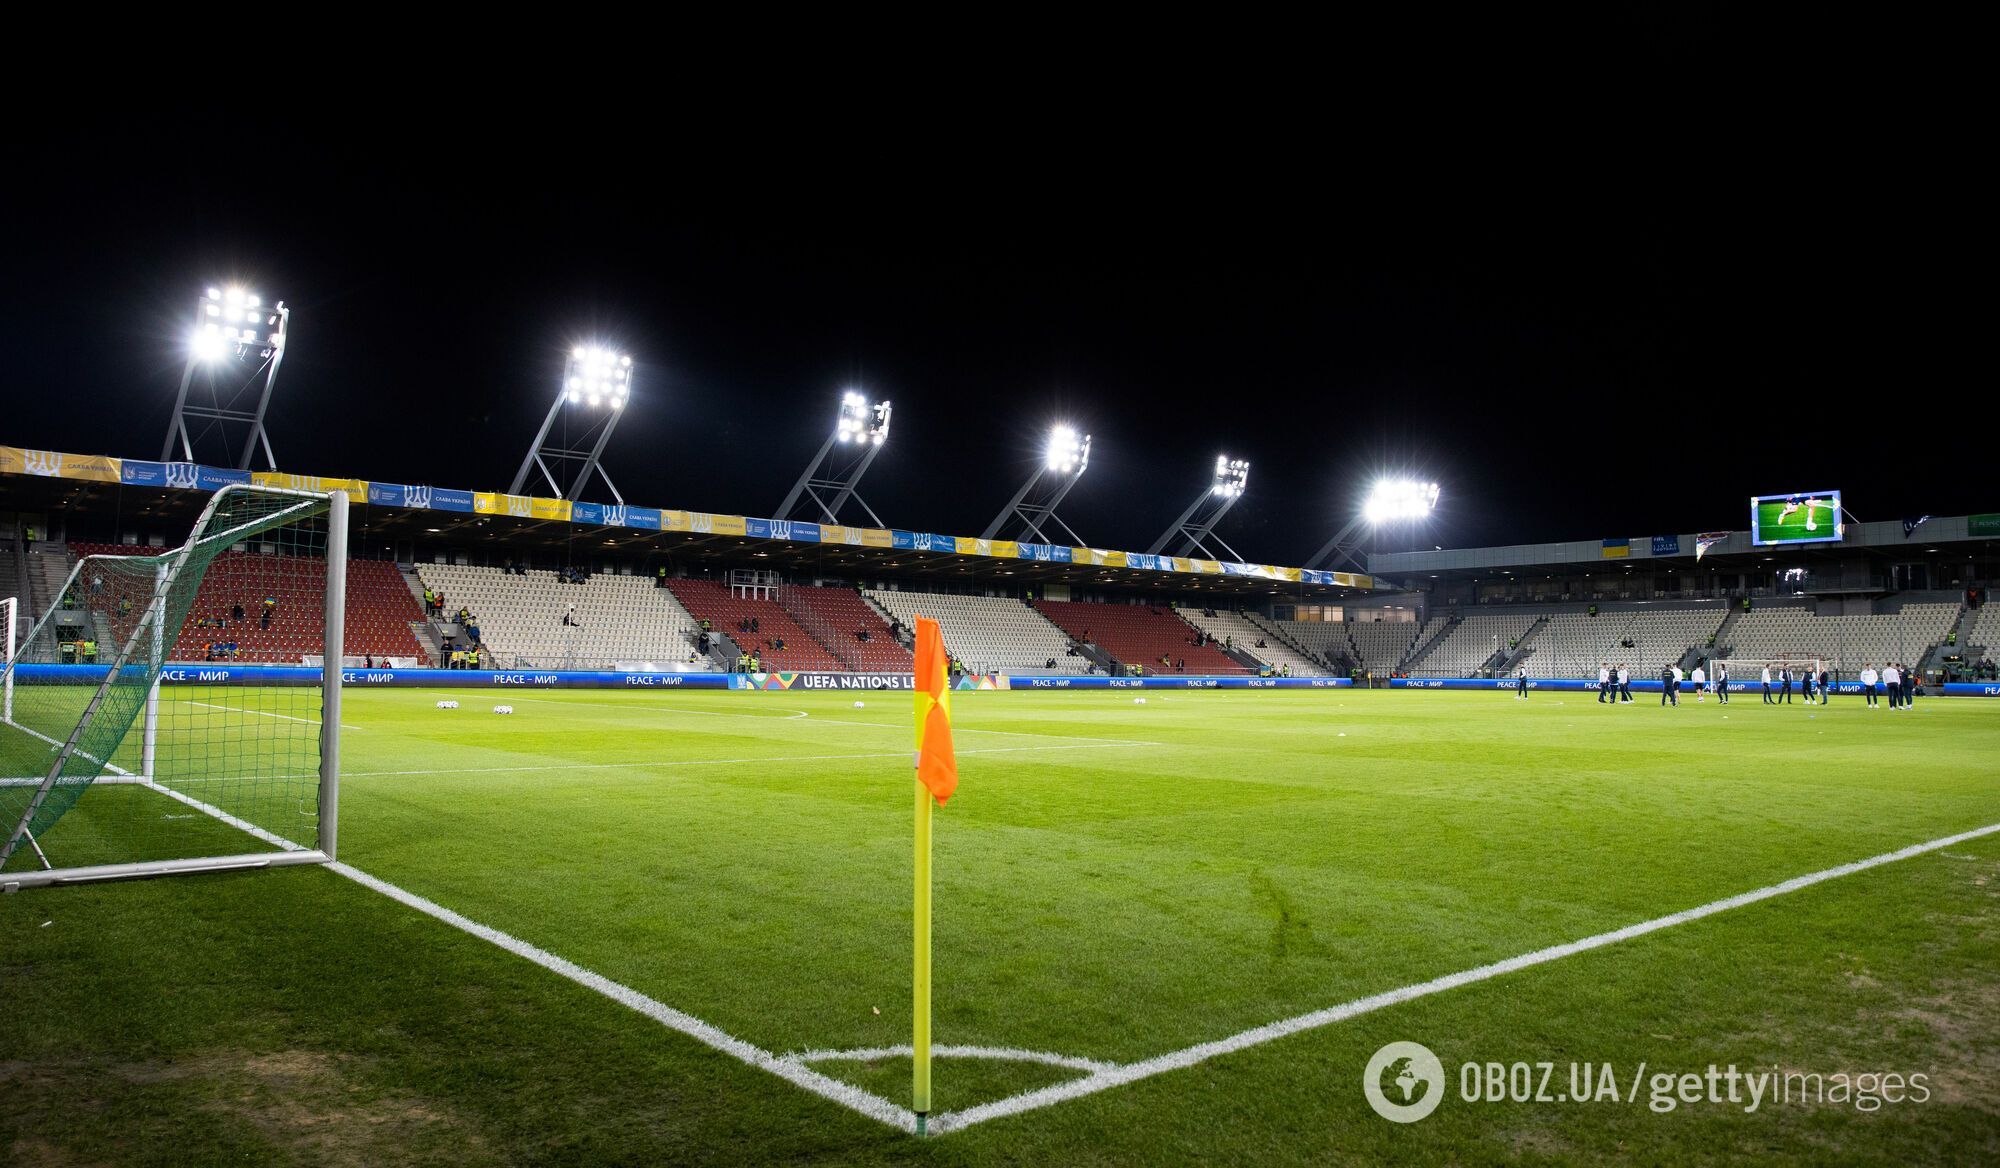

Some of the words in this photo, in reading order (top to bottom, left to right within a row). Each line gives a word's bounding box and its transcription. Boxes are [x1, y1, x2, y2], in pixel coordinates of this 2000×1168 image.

[199, 671, 229, 681] МИР
[367, 673, 394, 683] МИР
[494, 674, 525, 684] PEACE
[535, 675, 558, 684] МИР
[626, 676, 654, 685] PEACE
[662, 677, 683, 685] МИР
[803, 675, 838, 688] UEFA
[841, 676, 899, 688] NATIONS
[1032, 679, 1051, 687] PEACE
